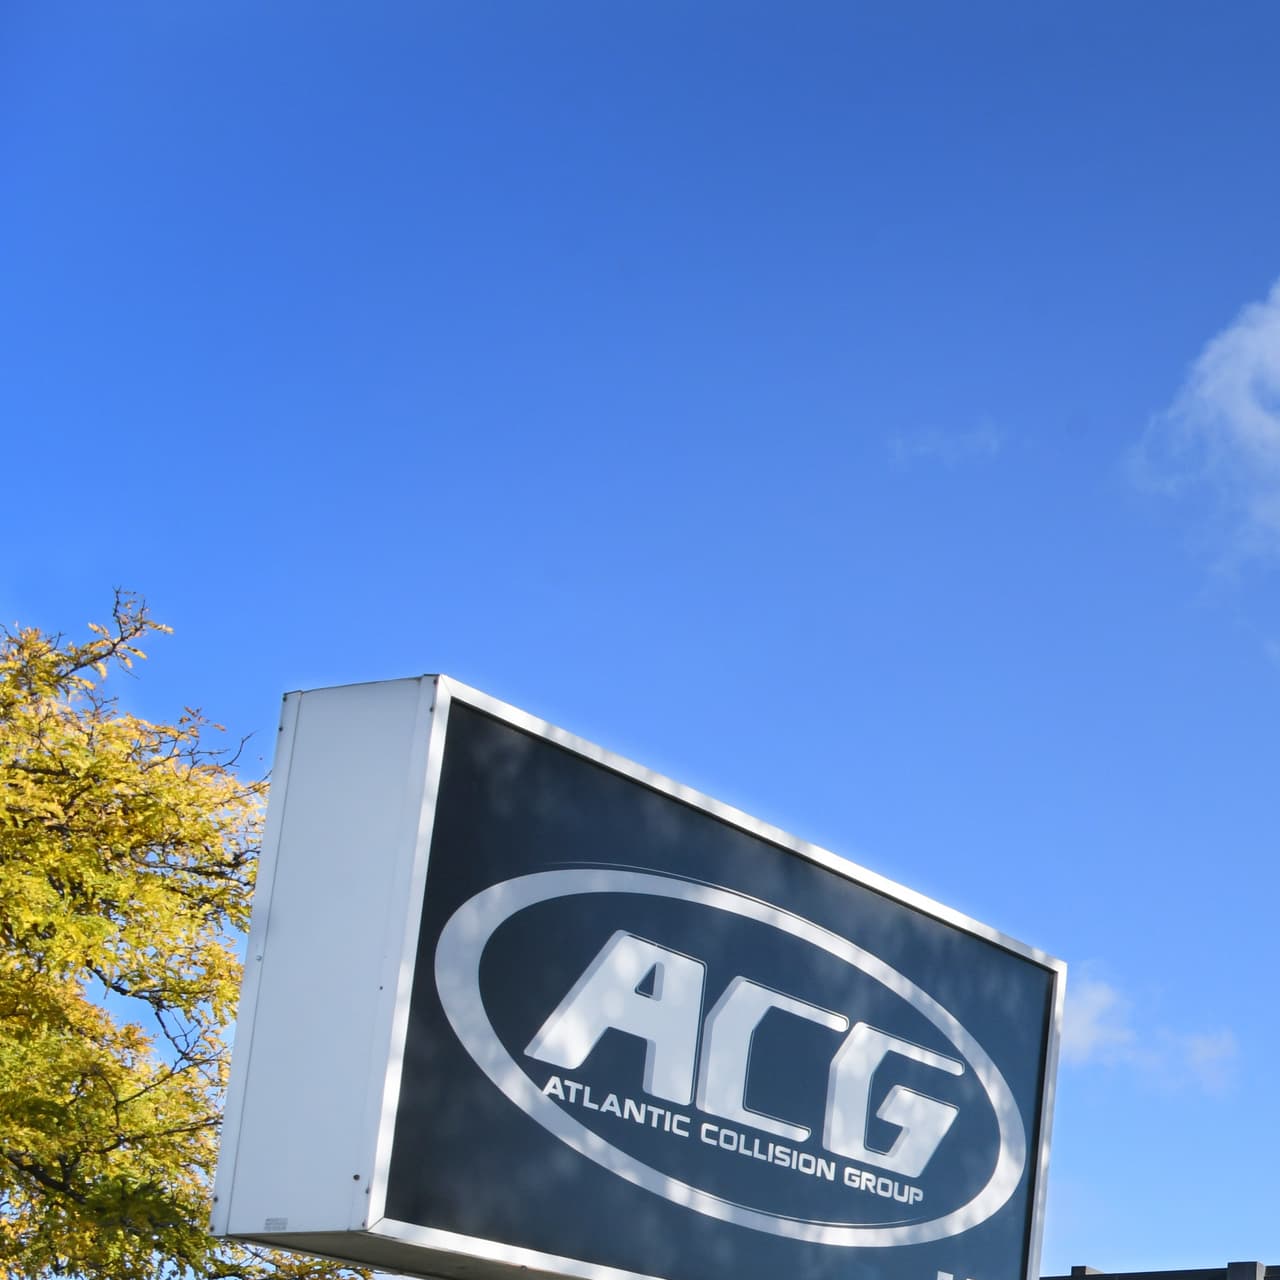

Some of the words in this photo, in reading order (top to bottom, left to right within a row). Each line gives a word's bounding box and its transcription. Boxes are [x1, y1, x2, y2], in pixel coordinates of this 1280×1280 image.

[523, 929, 965, 1179] ACG
[542, 1075, 691, 1138] ATLANTIC
[700, 1122, 836, 1182] COLLISION
[843, 1166, 924, 1206] GROUP
